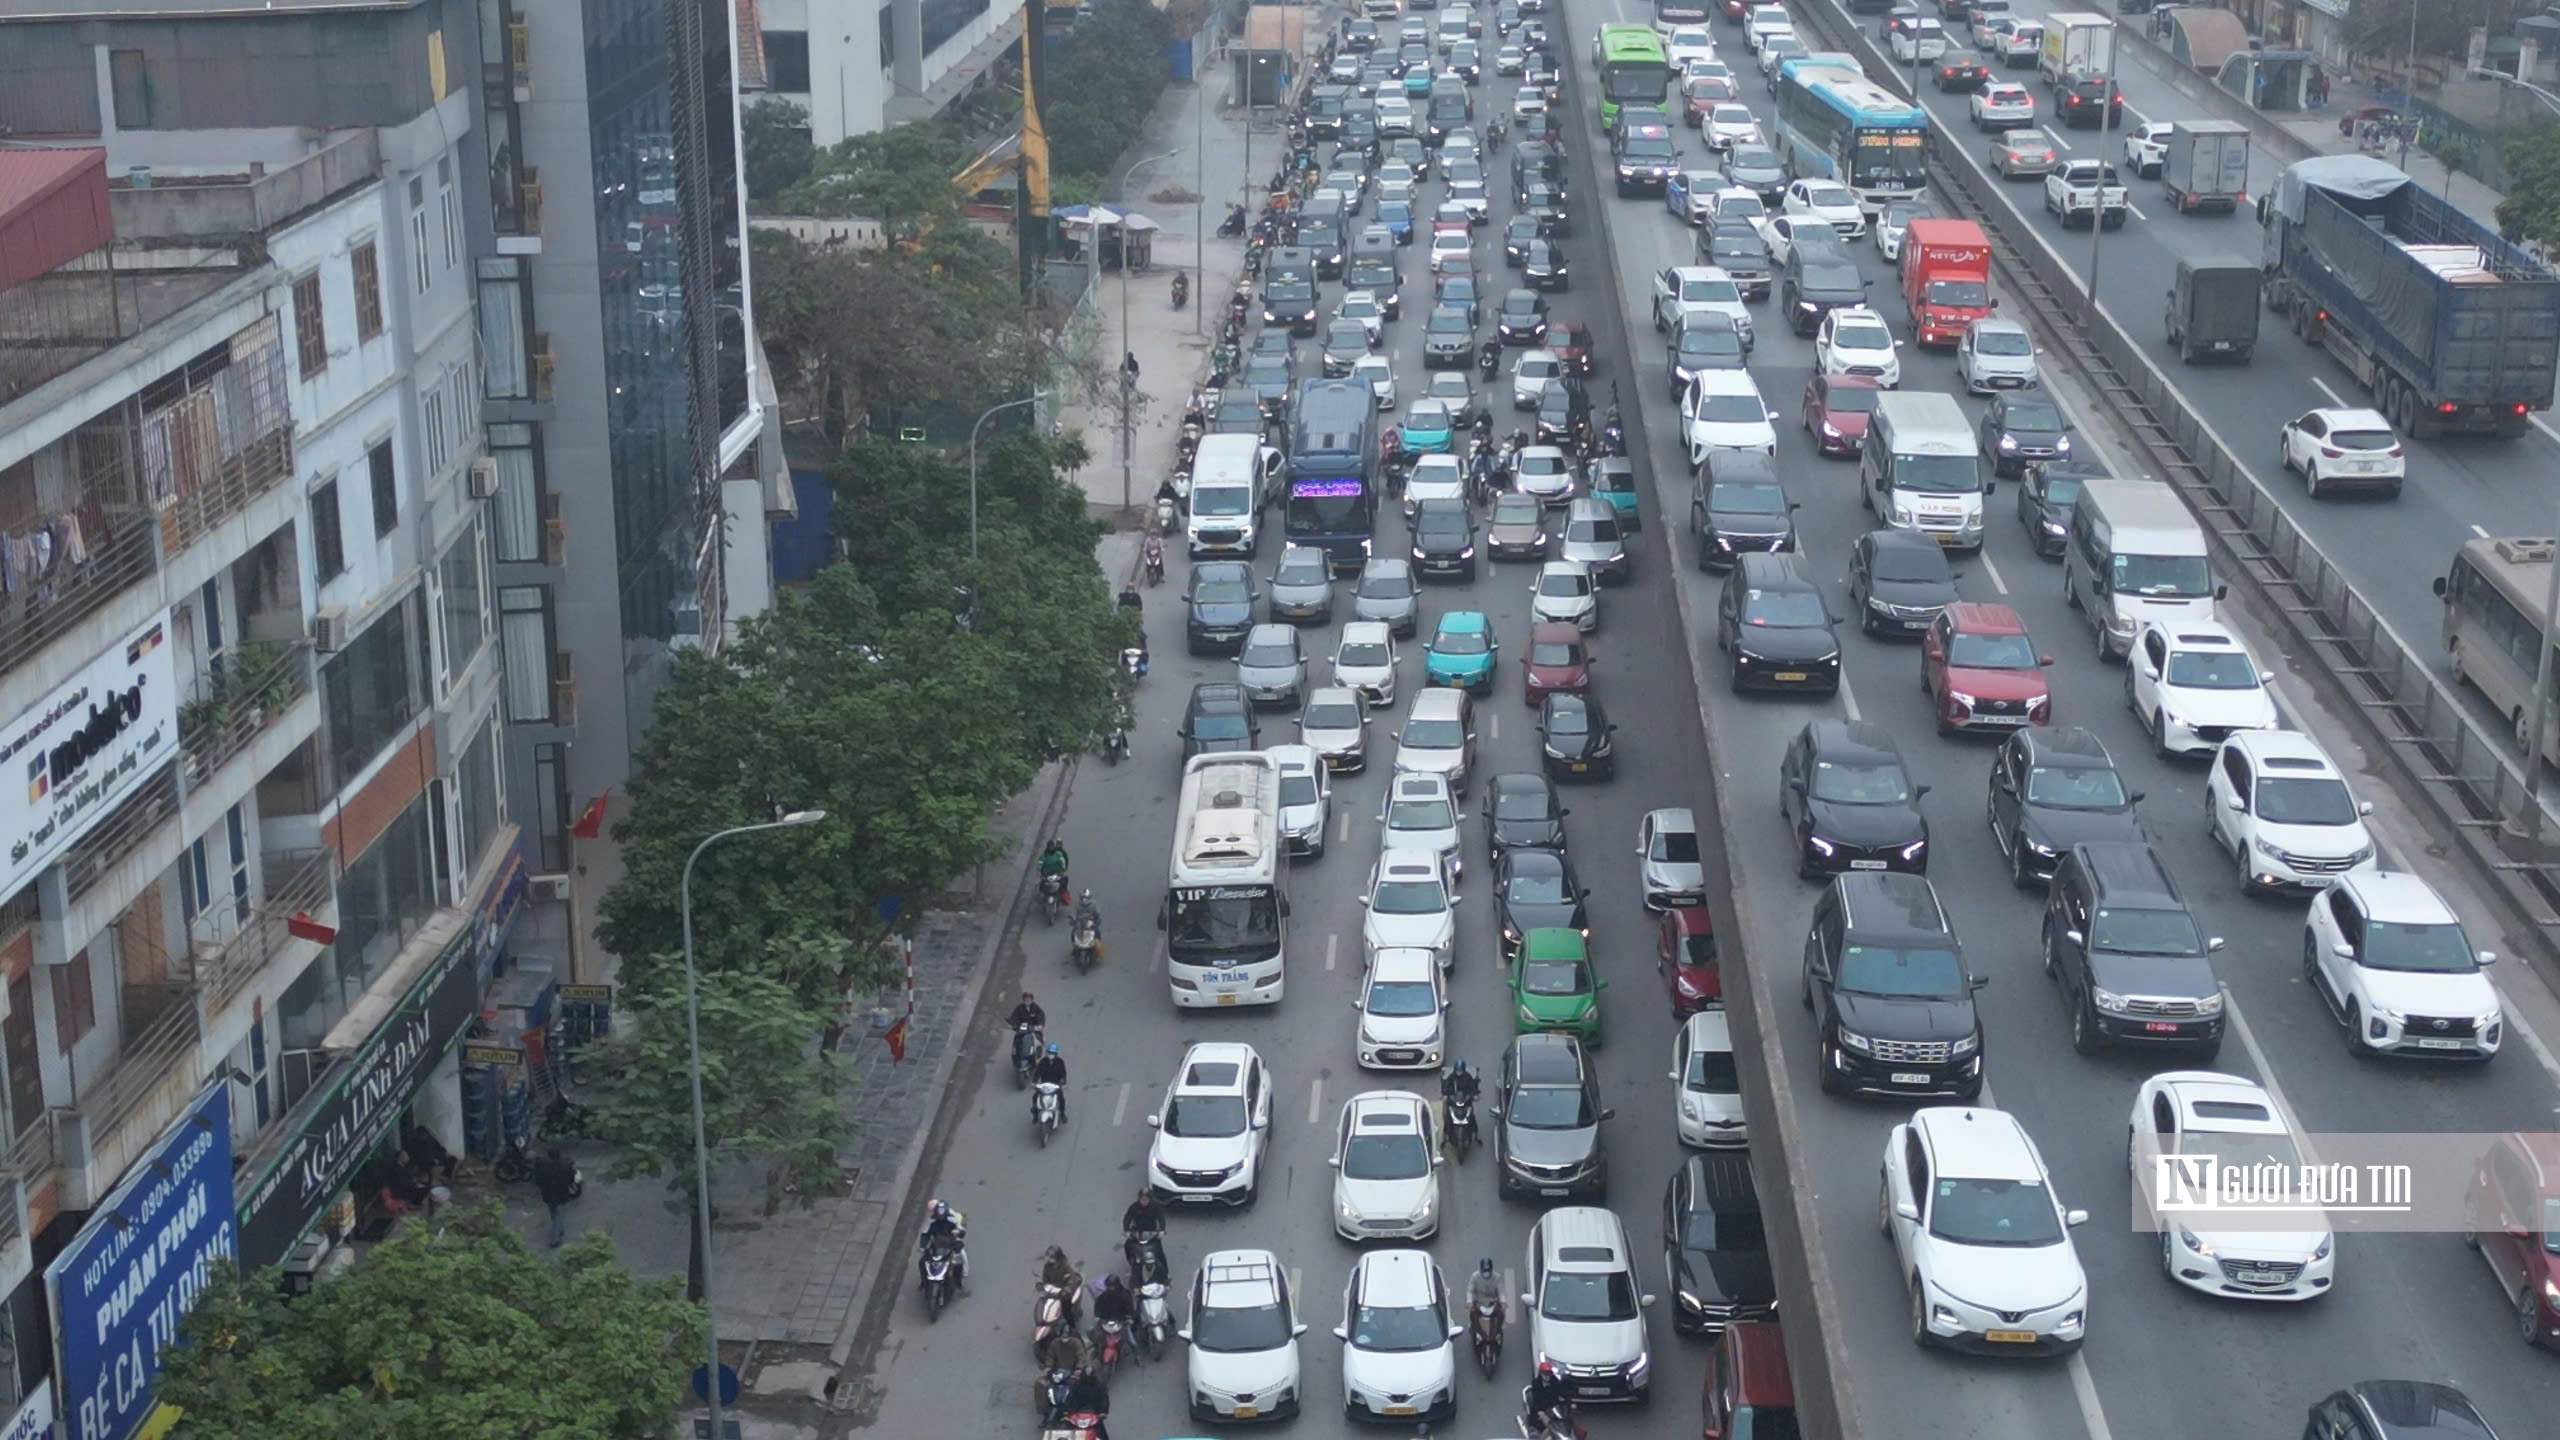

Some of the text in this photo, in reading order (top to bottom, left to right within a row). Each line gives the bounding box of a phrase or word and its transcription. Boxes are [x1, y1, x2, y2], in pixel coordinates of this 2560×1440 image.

[1176, 889, 1205, 901] VIP
[301, 1114, 349, 1199] AQUA
[97, 1178, 206, 1345] PHÂN PHỐI
[115, 1327, 145, 1414] CÁ
